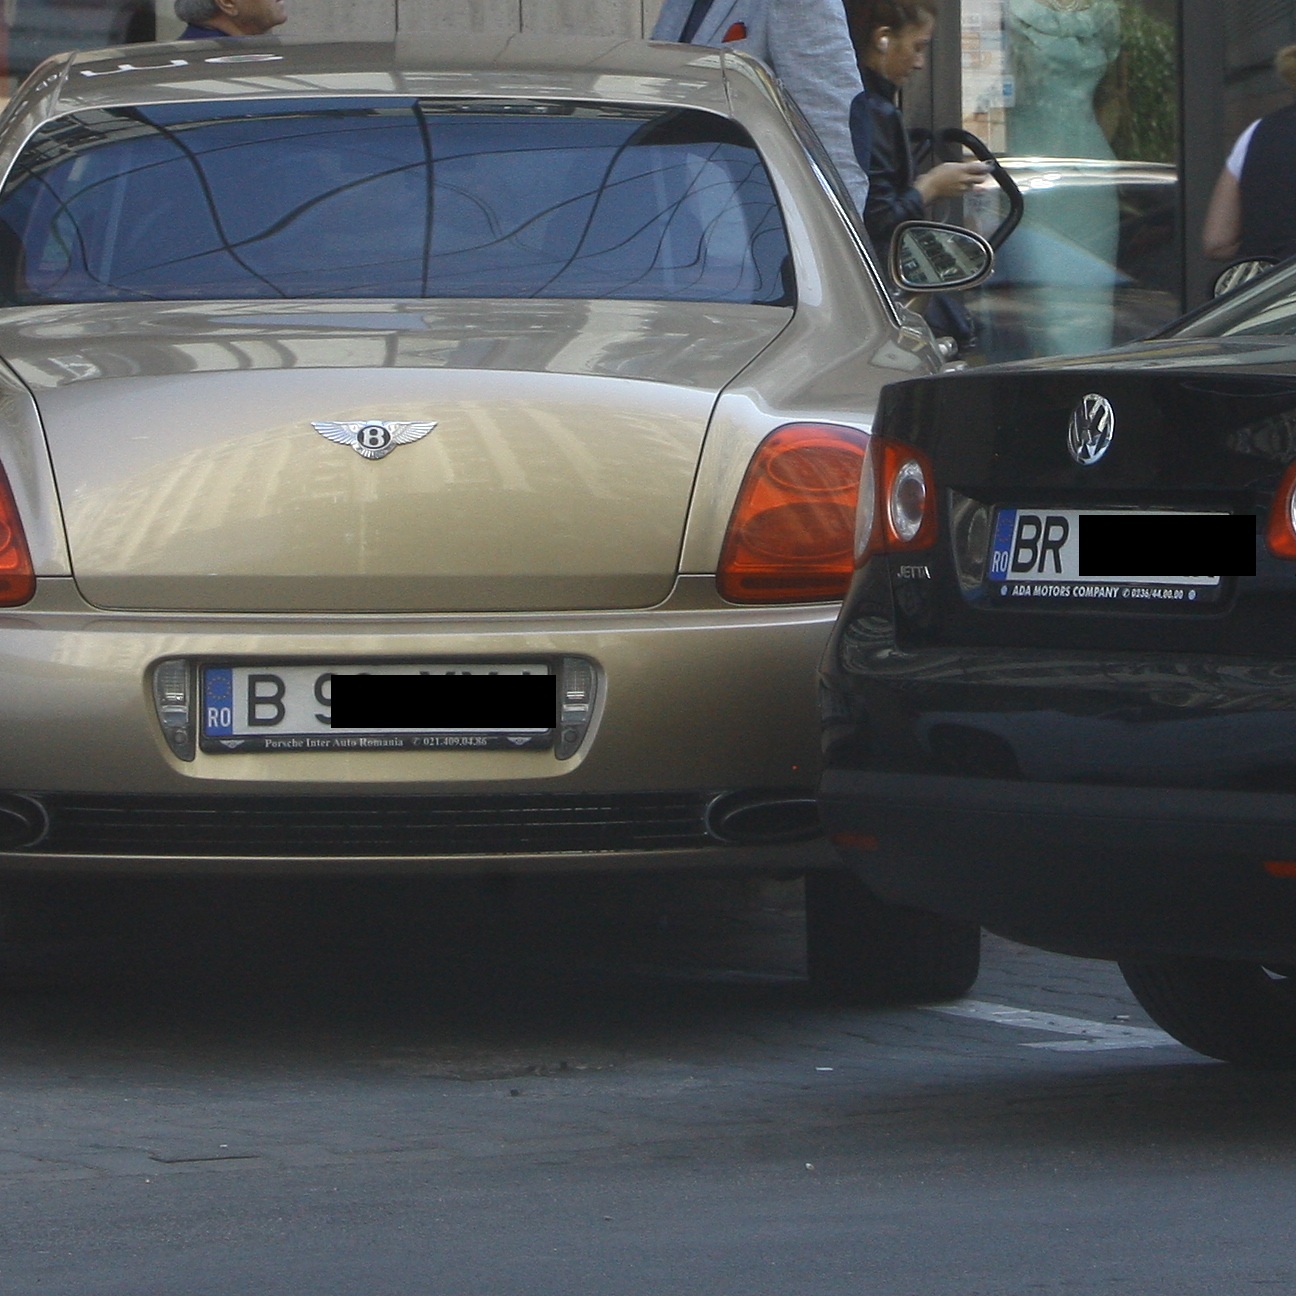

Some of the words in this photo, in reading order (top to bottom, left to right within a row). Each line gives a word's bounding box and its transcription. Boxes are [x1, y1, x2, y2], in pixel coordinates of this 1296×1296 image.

[1011, 515, 1070, 574] BR
[991, 550, 1009, 573] RO
[1011, 585, 1031, 597] ADA
[1032, 585, 1071, 598] MOTORS
[1072, 586, 1120, 599] COMPANY
[247, 674, 286, 727] B
[207, 707, 232, 728] RO
[264, 738, 304, 748] Porsche
[306, 738, 330, 748] Inter
[332, 737, 357, 747] Auto
[359, 737, 404, 747] Romania
